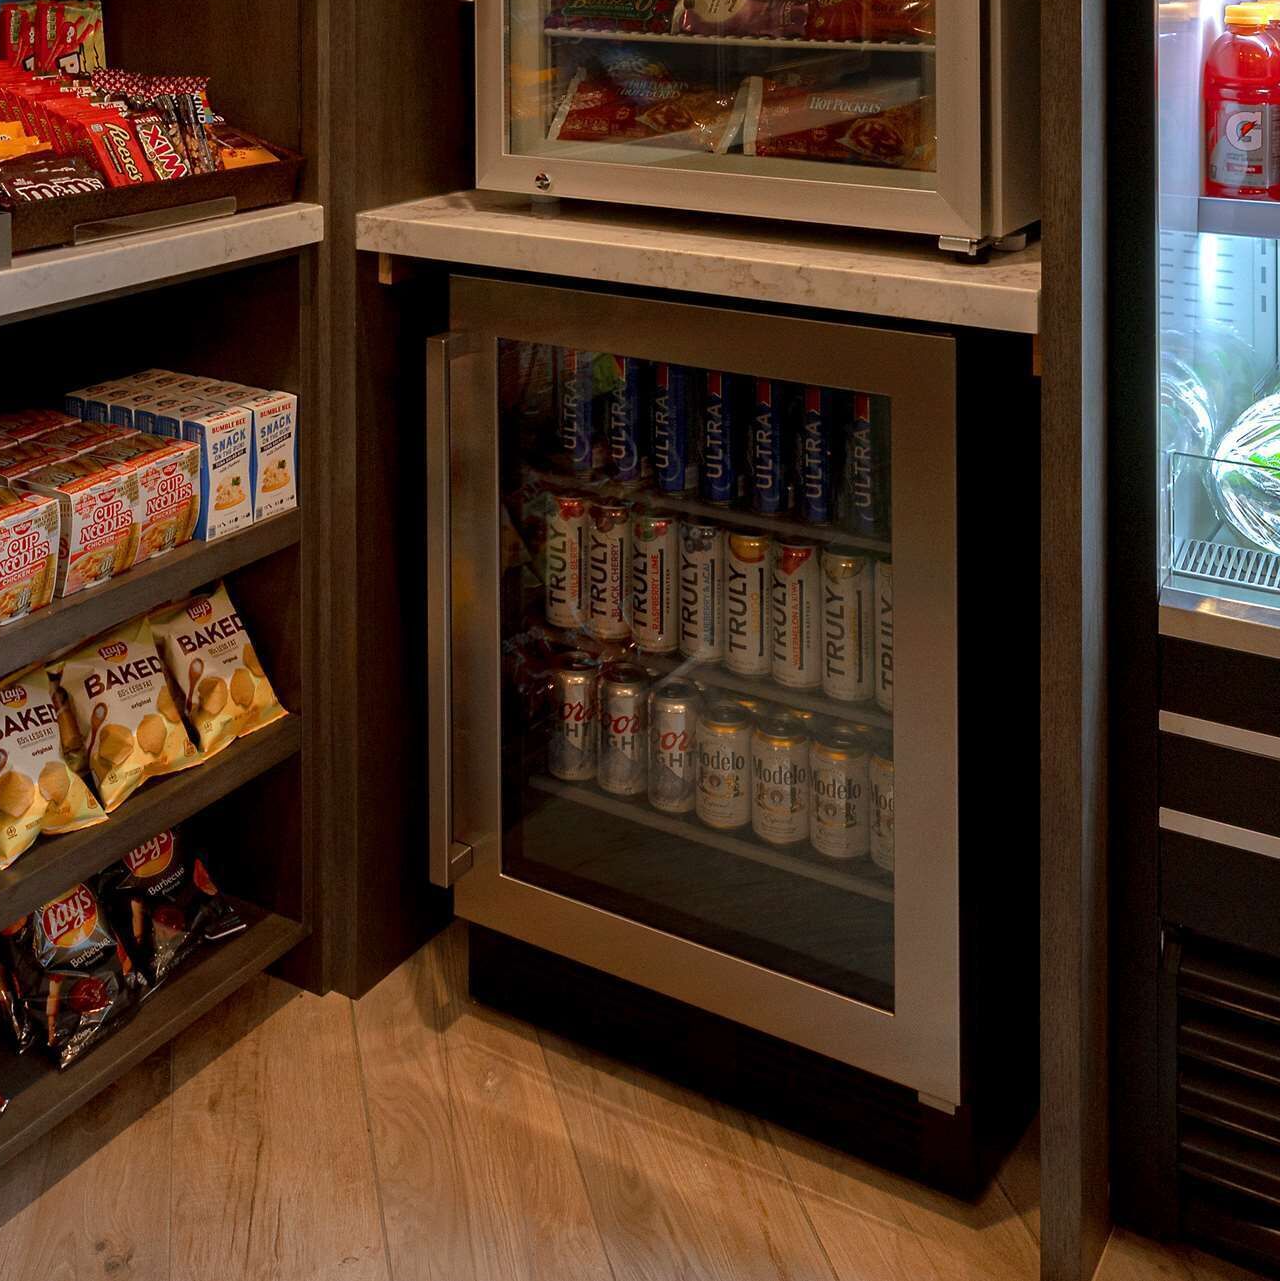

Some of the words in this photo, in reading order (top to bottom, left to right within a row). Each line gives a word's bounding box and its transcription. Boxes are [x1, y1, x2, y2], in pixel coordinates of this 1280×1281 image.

[194, 91, 207, 124] KIND
[1226, 111, 1262, 151] G
[212, 420, 234, 434] BUMBLE
[260, 413, 291, 438] SNACK
[562, 380, 578, 451] ULTRA
[610, 383, 626, 462] ULTRA
[655, 392, 669, 470] ULTRA
[212, 428, 246, 455] SNACK
[704, 402, 722, 480] ULTRA
[753, 411, 773, 490] ULTRA
[803, 418, 822, 500] ULTRA
[157, 473, 184, 497] CUP
[852, 427, 872, 508] ULTRA
[93, 500, 123, 524] CUP
[146, 482, 193, 517] NOODLES
[8, 532, 39, 557] CUP
[80, 509, 132, 545] NOODLES
[550, 523, 566, 607] TRULY
[590, 534, 607, 618] TRULY
[633, 544, 648, 627] TRULY
[682, 553, 698, 640] TRULY
[729, 564, 747, 653] TRULY
[773, 573, 786, 661] TRULY
[176, 615, 247, 656] BAKED
[826, 585, 845, 678] TRULY
[83, 655, 164, 699] BAKED
[130, 697, 152, 710] original
[753, 756, 807, 785] Modelo
[148, 867, 185, 896] Barbecue
[48, 889, 92, 937] Lay's
[70, 937, 111, 968] Barbecue
